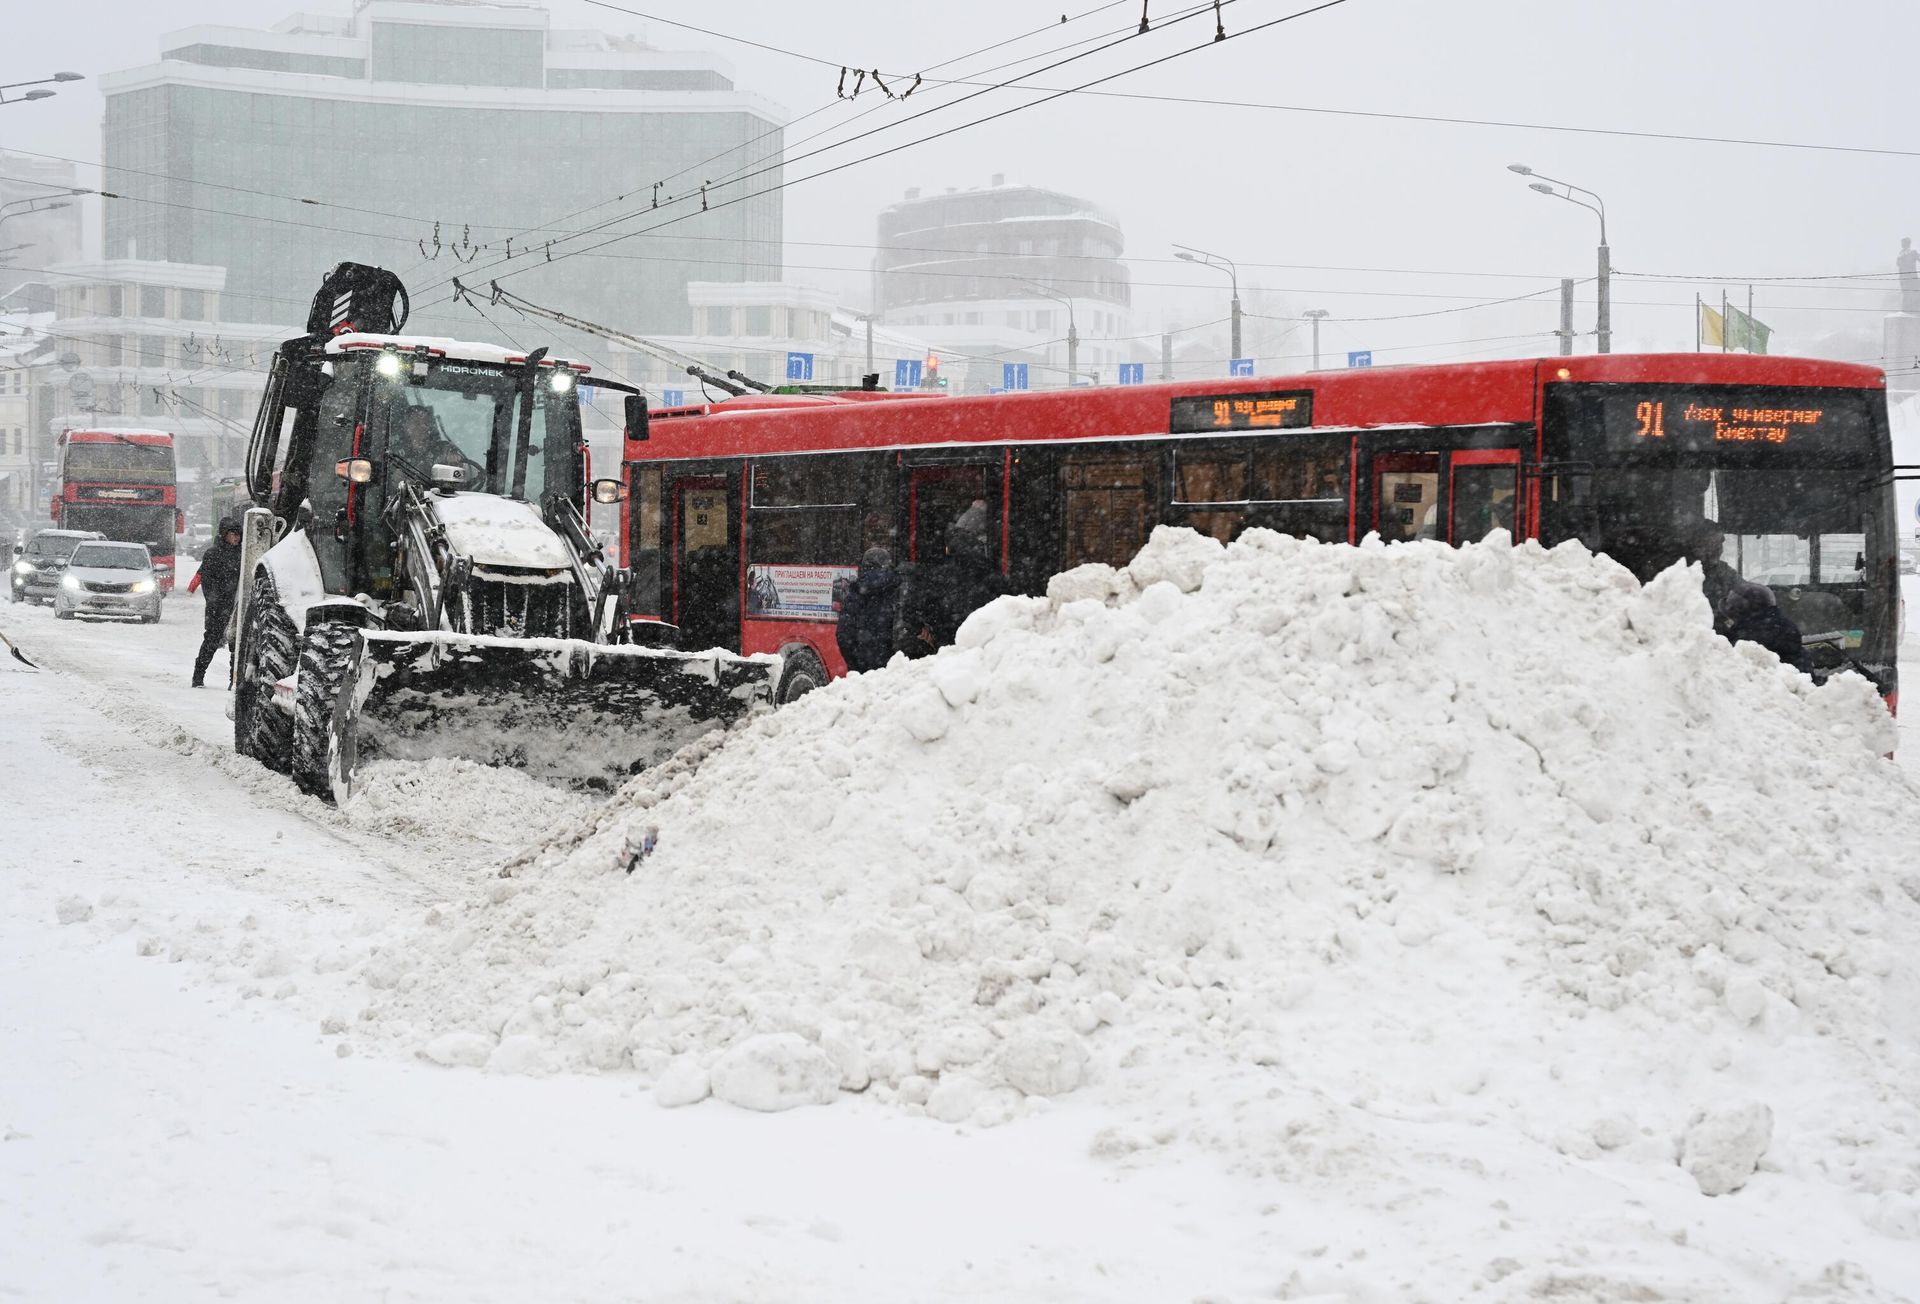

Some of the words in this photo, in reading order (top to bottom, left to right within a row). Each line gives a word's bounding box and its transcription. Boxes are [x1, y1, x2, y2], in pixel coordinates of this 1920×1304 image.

[1636, 401, 1664, 437] 91
[1732, 408, 1823, 425] универмаг
[1715, 422, 1788, 443] Биектау
[774, 570, 806, 579] ПРИГЛАШАЕМ
[806, 570, 814, 579] НА
[814, 570, 833, 580] РАБОТУ
